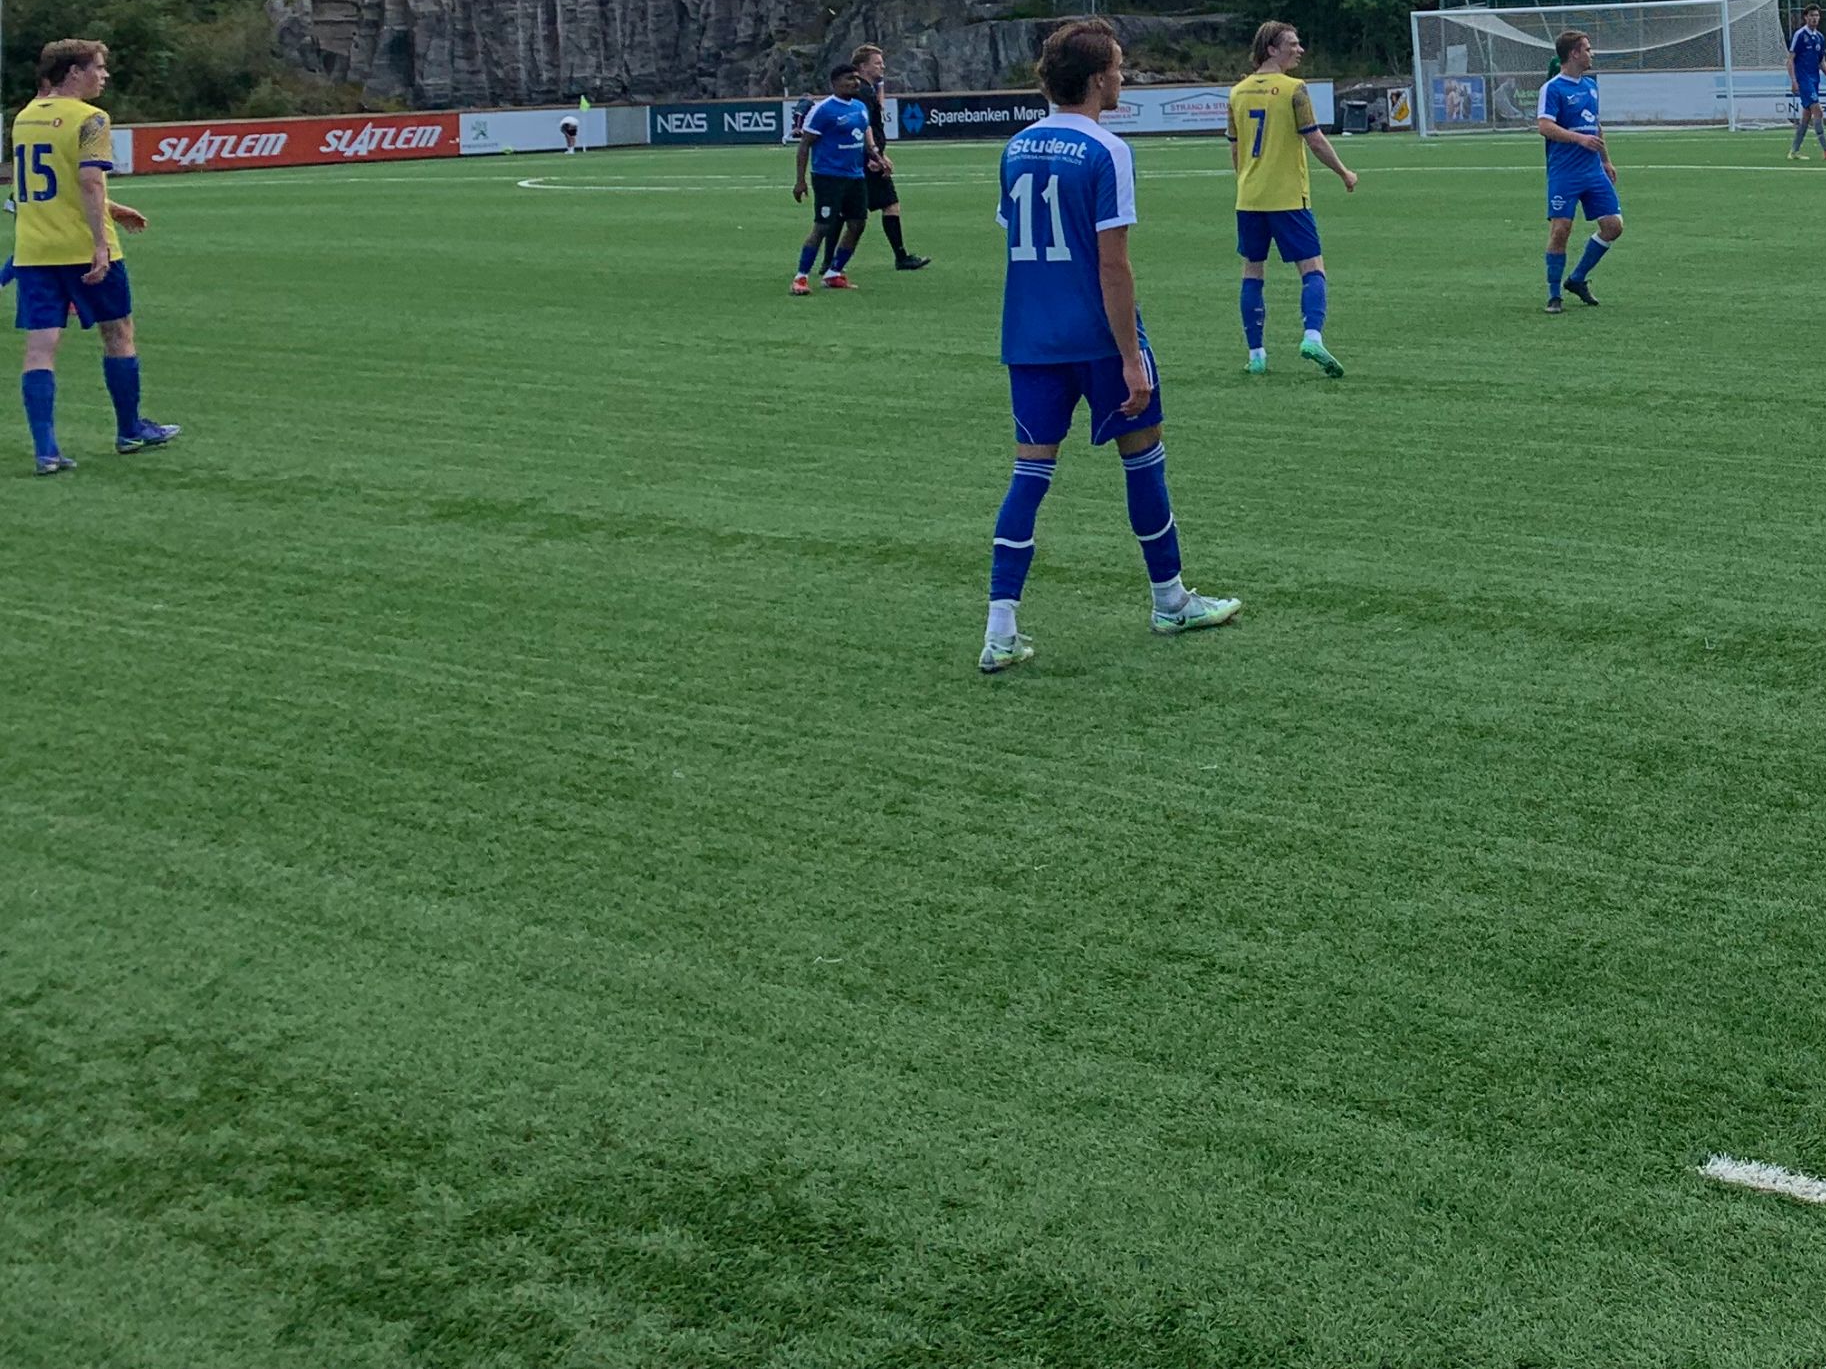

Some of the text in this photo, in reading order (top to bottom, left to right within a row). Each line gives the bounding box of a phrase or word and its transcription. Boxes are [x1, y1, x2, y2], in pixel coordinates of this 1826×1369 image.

[657, 113, 707, 133] NEAS
[724, 111, 776, 131] NEAS
[930, 106, 1046, 127] Sparebanken Møre
[1249, 109, 1267, 158] 7
[15, 143, 57, 202] 15
[1009, 173, 1072, 262] 11
